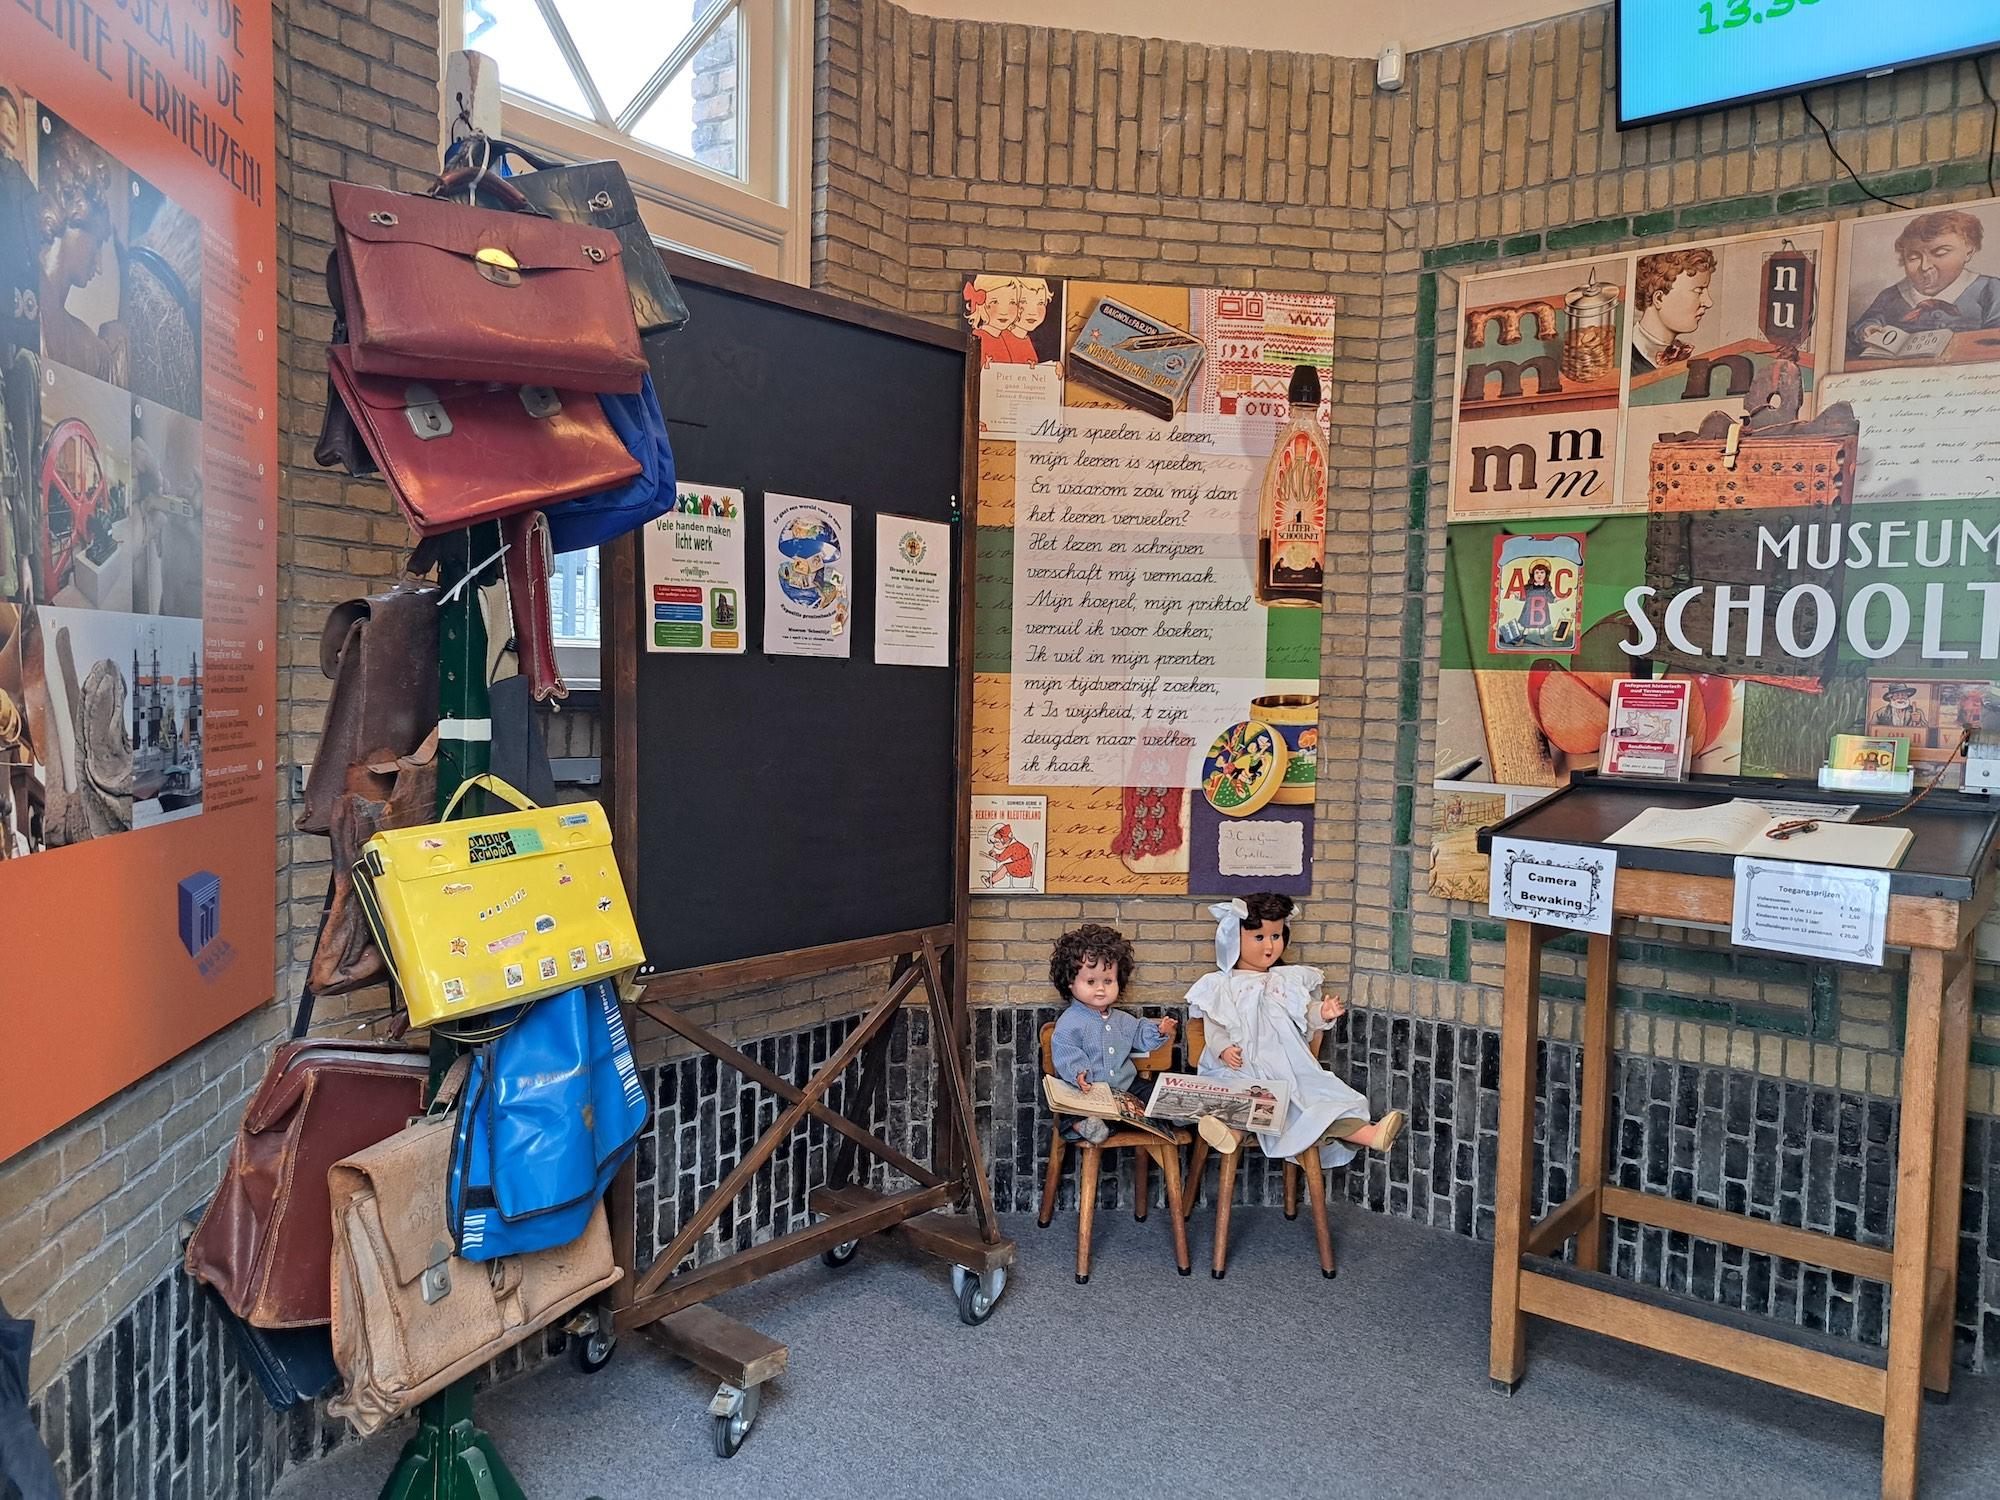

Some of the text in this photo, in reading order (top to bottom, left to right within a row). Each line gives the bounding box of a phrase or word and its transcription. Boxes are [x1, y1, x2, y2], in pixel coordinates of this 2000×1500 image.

[184, 22, 244, 125] IN DE
[123, 39, 262, 208] TERNEUZEN!
[1774, 264, 1797, 292] n
[1465, 301, 1558, 349] m
[1772, 299, 1796, 330] u
[996, 372, 1012, 381] Piet
[1031, 374, 1046, 382] Nel
[1464, 353, 1563, 401] m
[1680, 352, 1757, 400] n
[1031, 419, 1077, 443] Mijn
[1082, 423, 1141, 445] speelen
[1147, 426, 1161, 440] is
[1029, 452, 1069, 473] mijn
[1072, 454, 1120, 469] leeren
[1125, 457, 1141, 469] is
[1470, 427, 1604, 493] m m
[1031, 476, 1238, 506] En waarom zou mij dan
[1026, 505, 1191, 527] het leeren verveelen?
[1296, 510, 1302, 523] 1
[656, 519, 731, 538] Vele handen maken
[1288, 524, 1310, 532] LITER
[675, 533, 713, 551] licht werk
[1028, 533, 1205, 560] Het lezen en schrijven
[1755, 519, 2000, 570] MUSEUM
[1026, 563, 1217, 588] verschaft mij vermaak.
[1026, 590, 1073, 615] Mijn
[1143, 597, 1182, 615] mijn
[1187, 595, 1252, 616] priktol
[1504, 568, 1573, 626] A B C
[1025, 621, 1080, 636] verruil
[1087, 622, 1104, 636] ik
[1110, 627, 1147, 638] voor
[1025, 645, 1216, 671] Ik wil in mijn prenten
[1023, 678, 1063, 695] mijn
[1068, 677, 1159, 697] tijdverdrijf
[1040, 701, 1059, 718] Is
[1157, 707, 1189, 725] zijn
[1021, 729, 1197, 750] deugden naar welken
[1021, 755, 1095, 773] ik haak.
[469, 832, 508, 847] BASIS
[471, 847, 512, 861] SCHOOL
[1528, 872, 1577, 887] Camera
[1520, 891, 1582, 910] Bewaking
[1778, 885, 1841, 899] Toegangsprijzen
[1755, 922, 1791, 931] Rondleidingen
[1756, 912, 1778, 920] Kinderen
